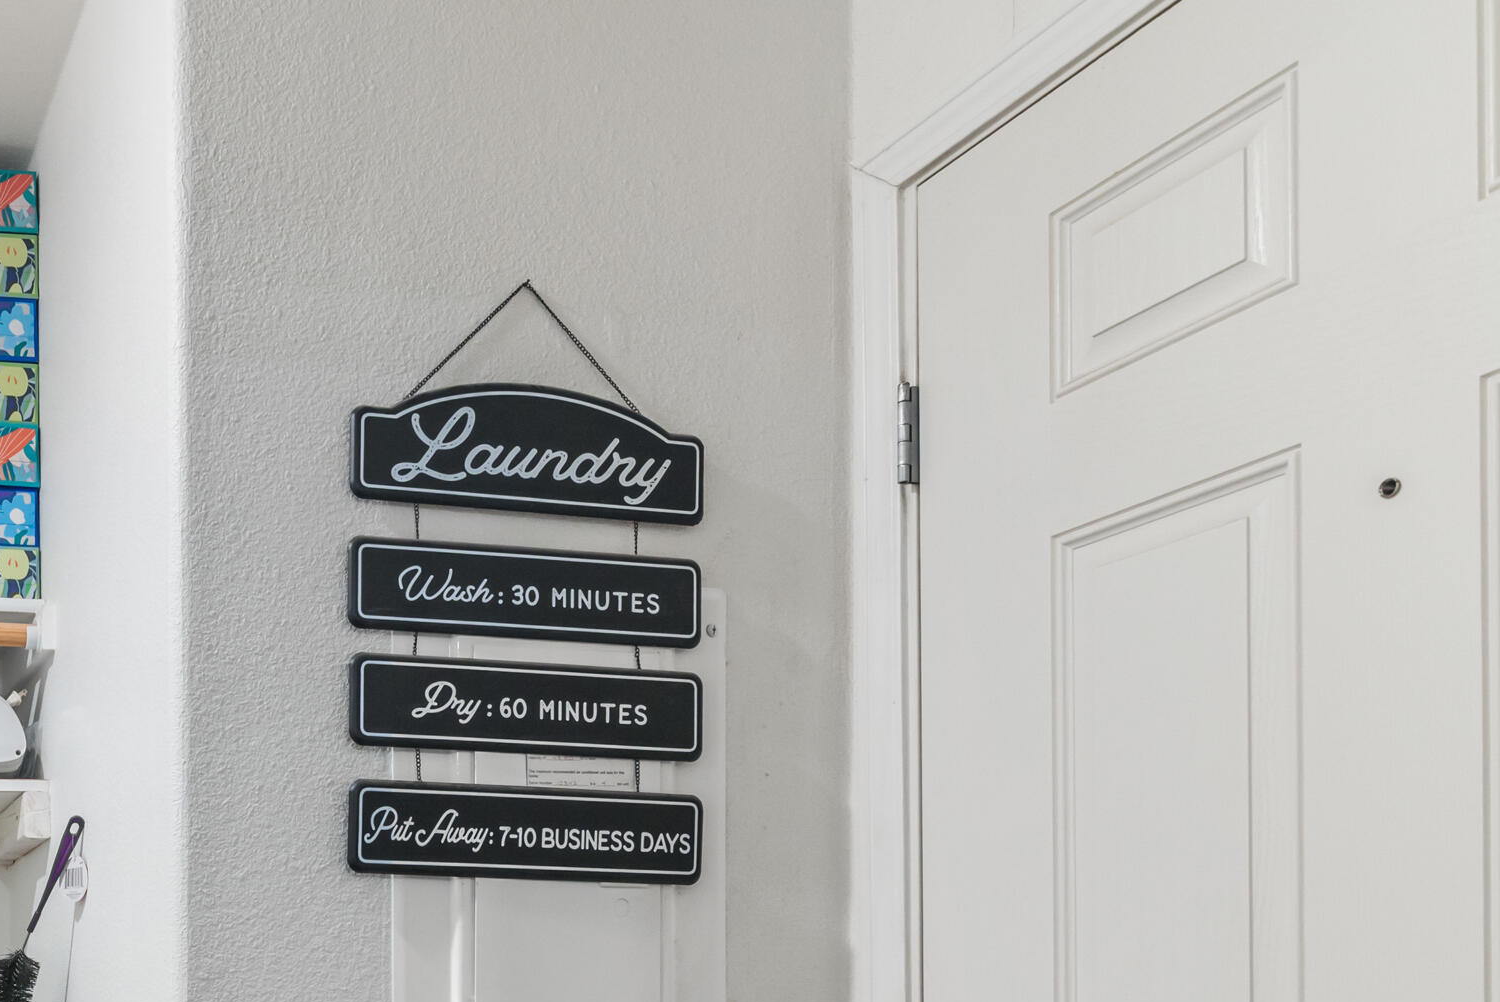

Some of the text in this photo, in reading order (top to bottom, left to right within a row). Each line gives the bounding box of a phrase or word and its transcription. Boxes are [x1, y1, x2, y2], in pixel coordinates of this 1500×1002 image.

[391, 407, 671, 505] Laundry
[512, 585, 539, 606] 30
[552, 588, 660, 615] MINUTES
[500, 697, 527, 719] 60
[539, 699, 648, 726] MINUTES
[364, 806, 691, 854] Put Away: 7-10 BUSINESS DAYS
